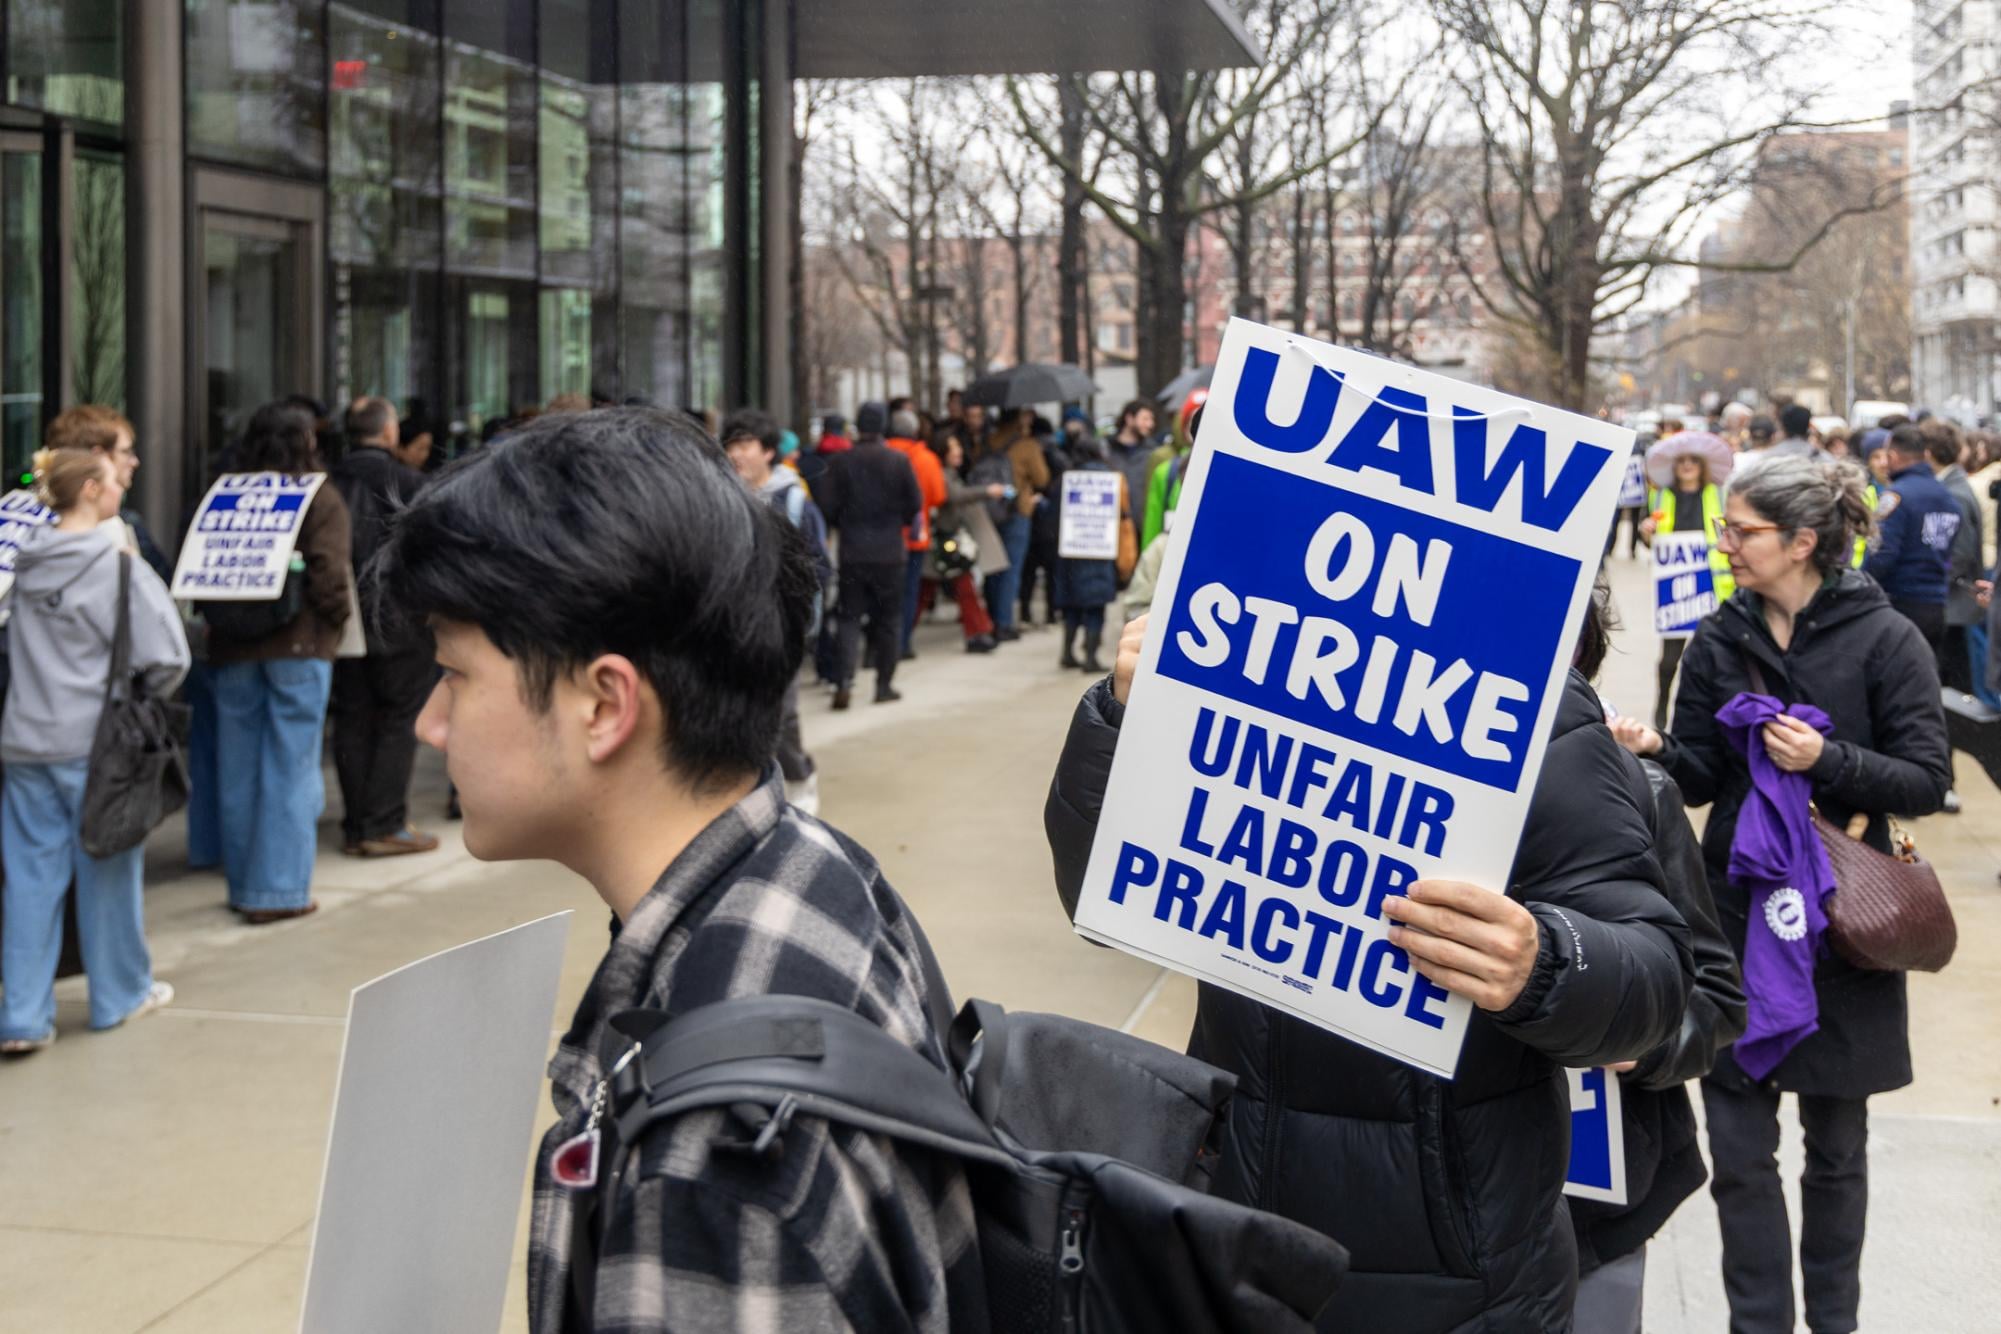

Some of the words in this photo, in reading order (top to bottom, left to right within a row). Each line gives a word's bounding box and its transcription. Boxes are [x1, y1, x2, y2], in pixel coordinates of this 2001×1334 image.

[1233, 346, 1614, 532] UAW
[1304, 511, 1453, 627] ON
[1176, 582, 1530, 763] STRIKE
[1180, 786, 1420, 927] LABOR
[1188, 706, 1456, 859] UNFAIR
[1107, 841, 1450, 1031] PRACTICE
